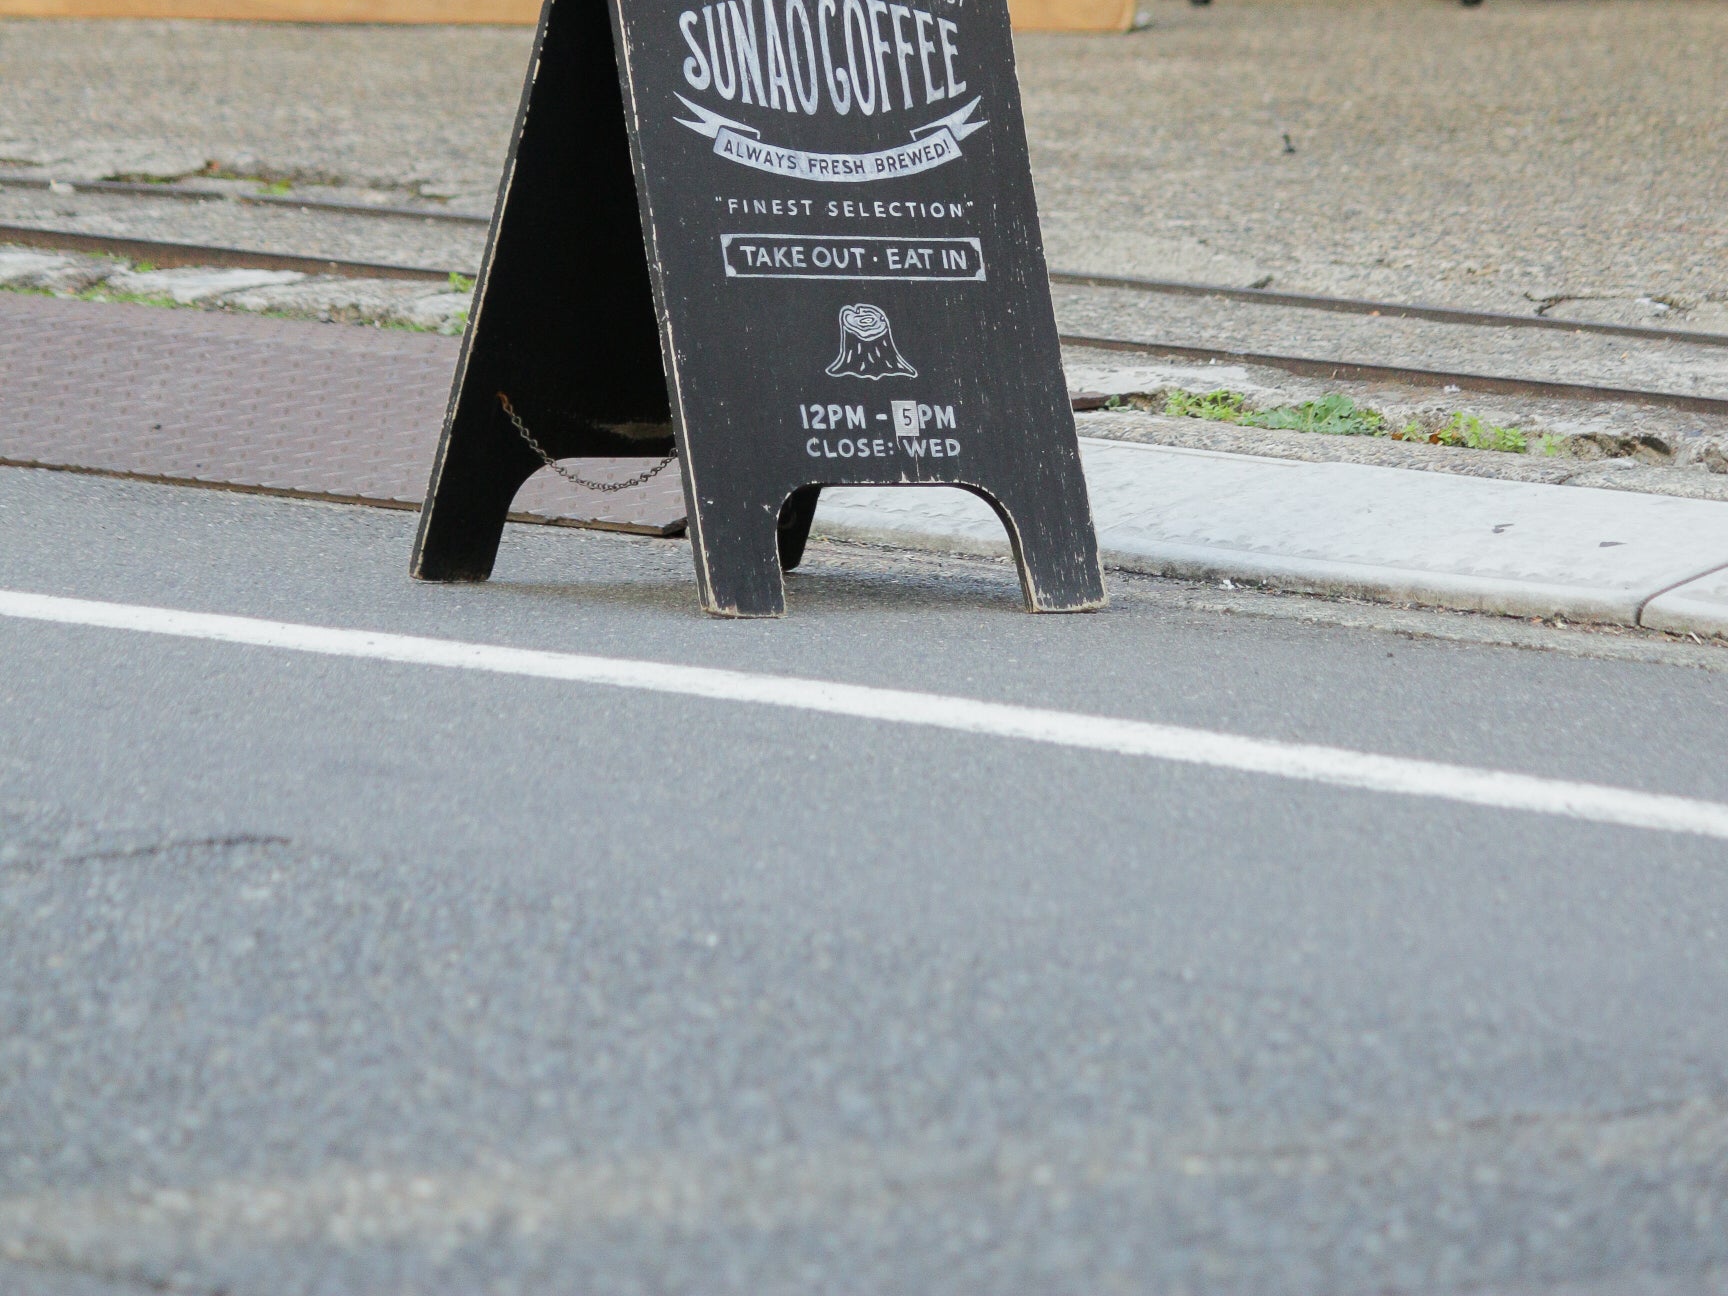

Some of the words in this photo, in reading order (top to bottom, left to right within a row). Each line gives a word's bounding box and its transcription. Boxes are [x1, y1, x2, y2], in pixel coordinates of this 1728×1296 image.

[723, 140, 797, 169] ALWAYS
[808, 158, 865, 175] FRESH
[875, 138, 952, 172] BREWED!
[739, 245, 805, 267] TAKE
[811, 247, 865, 269] OUT
[886, 248, 933, 269] EAT
[941, 249, 967, 270] IN
[800, 404, 866, 429] 12PM
[902, 404, 956, 429] 5PM
[806, 438, 894, 457] CLOSE:
[903, 439, 960, 457] WED
